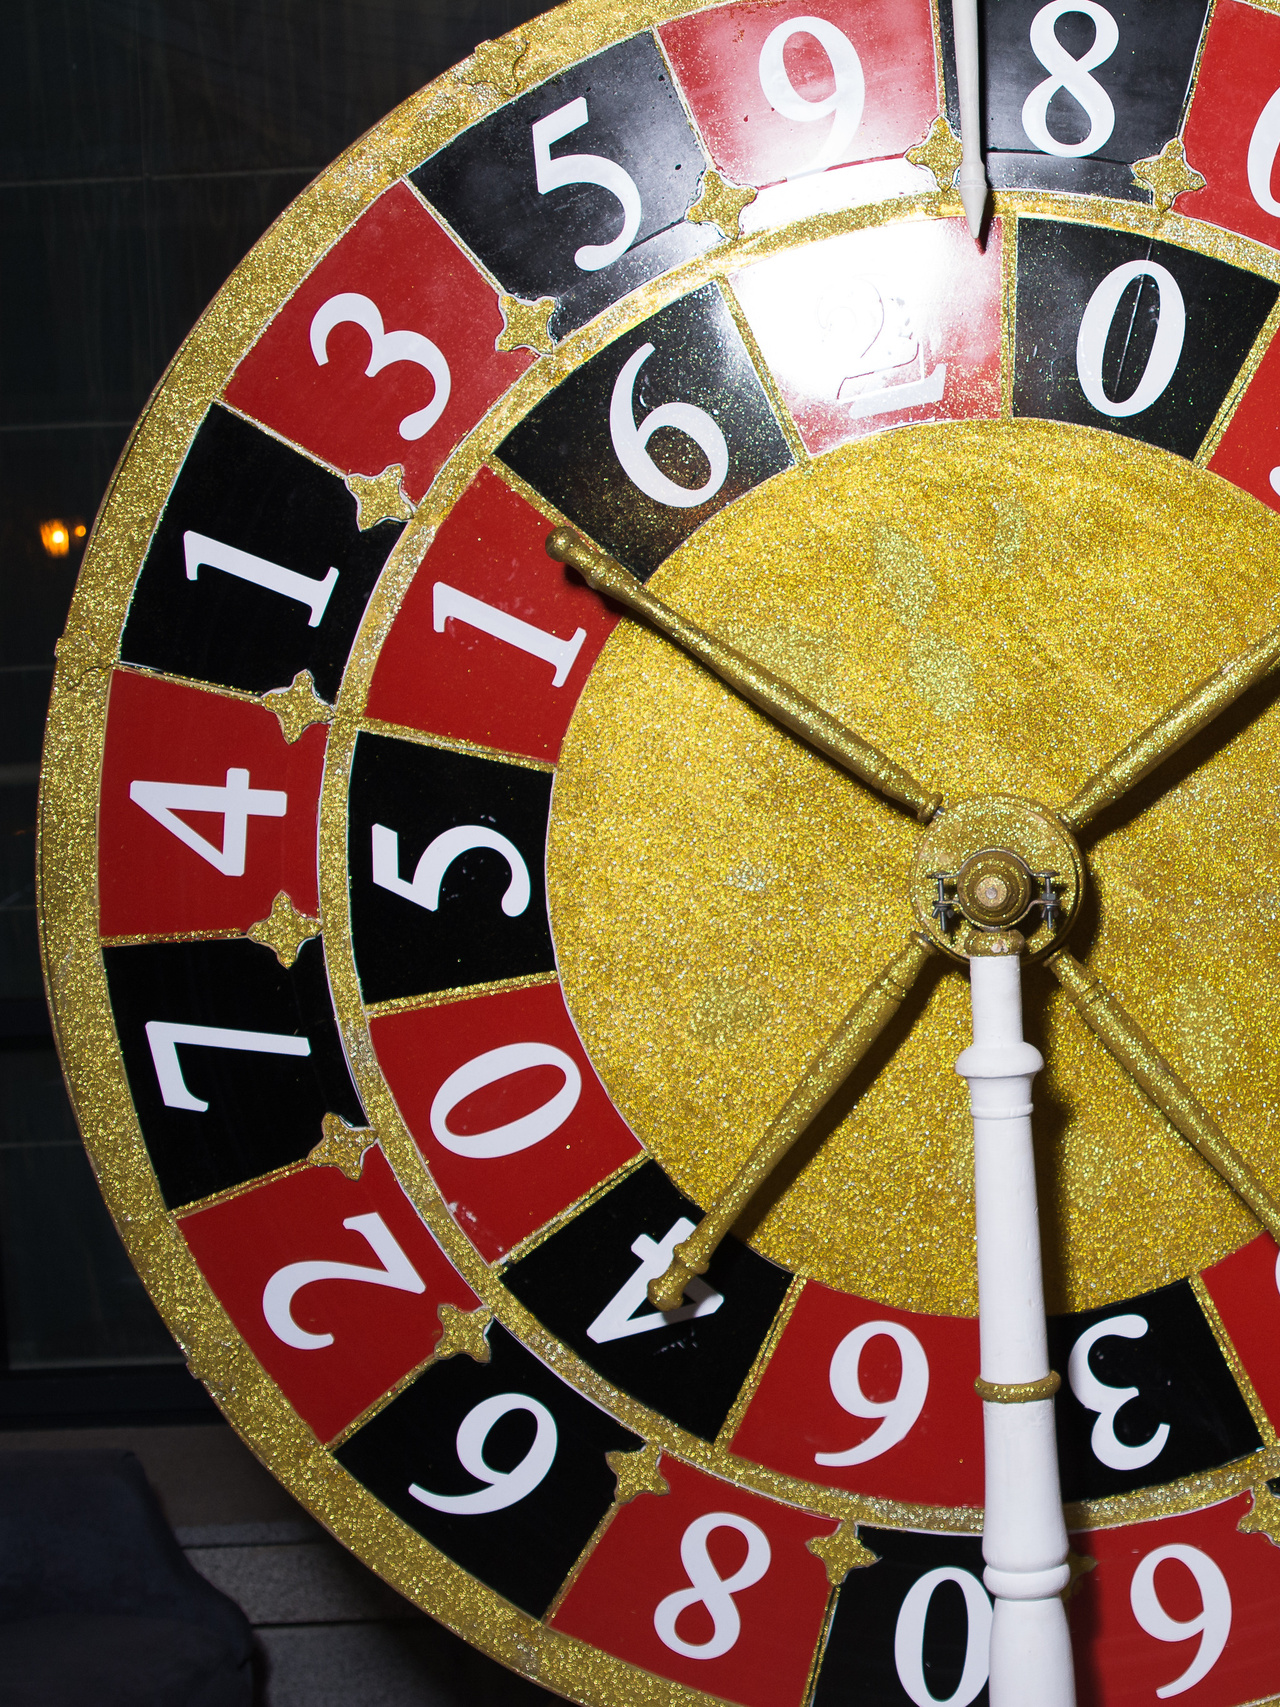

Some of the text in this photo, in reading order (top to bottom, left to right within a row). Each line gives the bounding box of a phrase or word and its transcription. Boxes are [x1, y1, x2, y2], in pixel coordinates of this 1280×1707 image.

[758, 16, 867, 174] 9
[1021, 0, 1120, 158] 8
[532, 97, 642, 272] 5
[311, 293, 451, 440] 3
[1076, 260, 1185, 416] 0
[610, 343, 729, 508] 6
[184, 531, 338, 626] 1
[434, 582, 586, 687] 1
[131, 768, 287, 876] 4
[373, 824, 529, 916] 5
[147, 1021, 310, 1111] 7
[431, 1043, 581, 1157] 0
[264, 1213, 425, 1349] 2
[1073, 1315, 1169, 1469] 3
[655, 1513, 770, 1658] 8
[895, 1568, 991, 1707] 0
